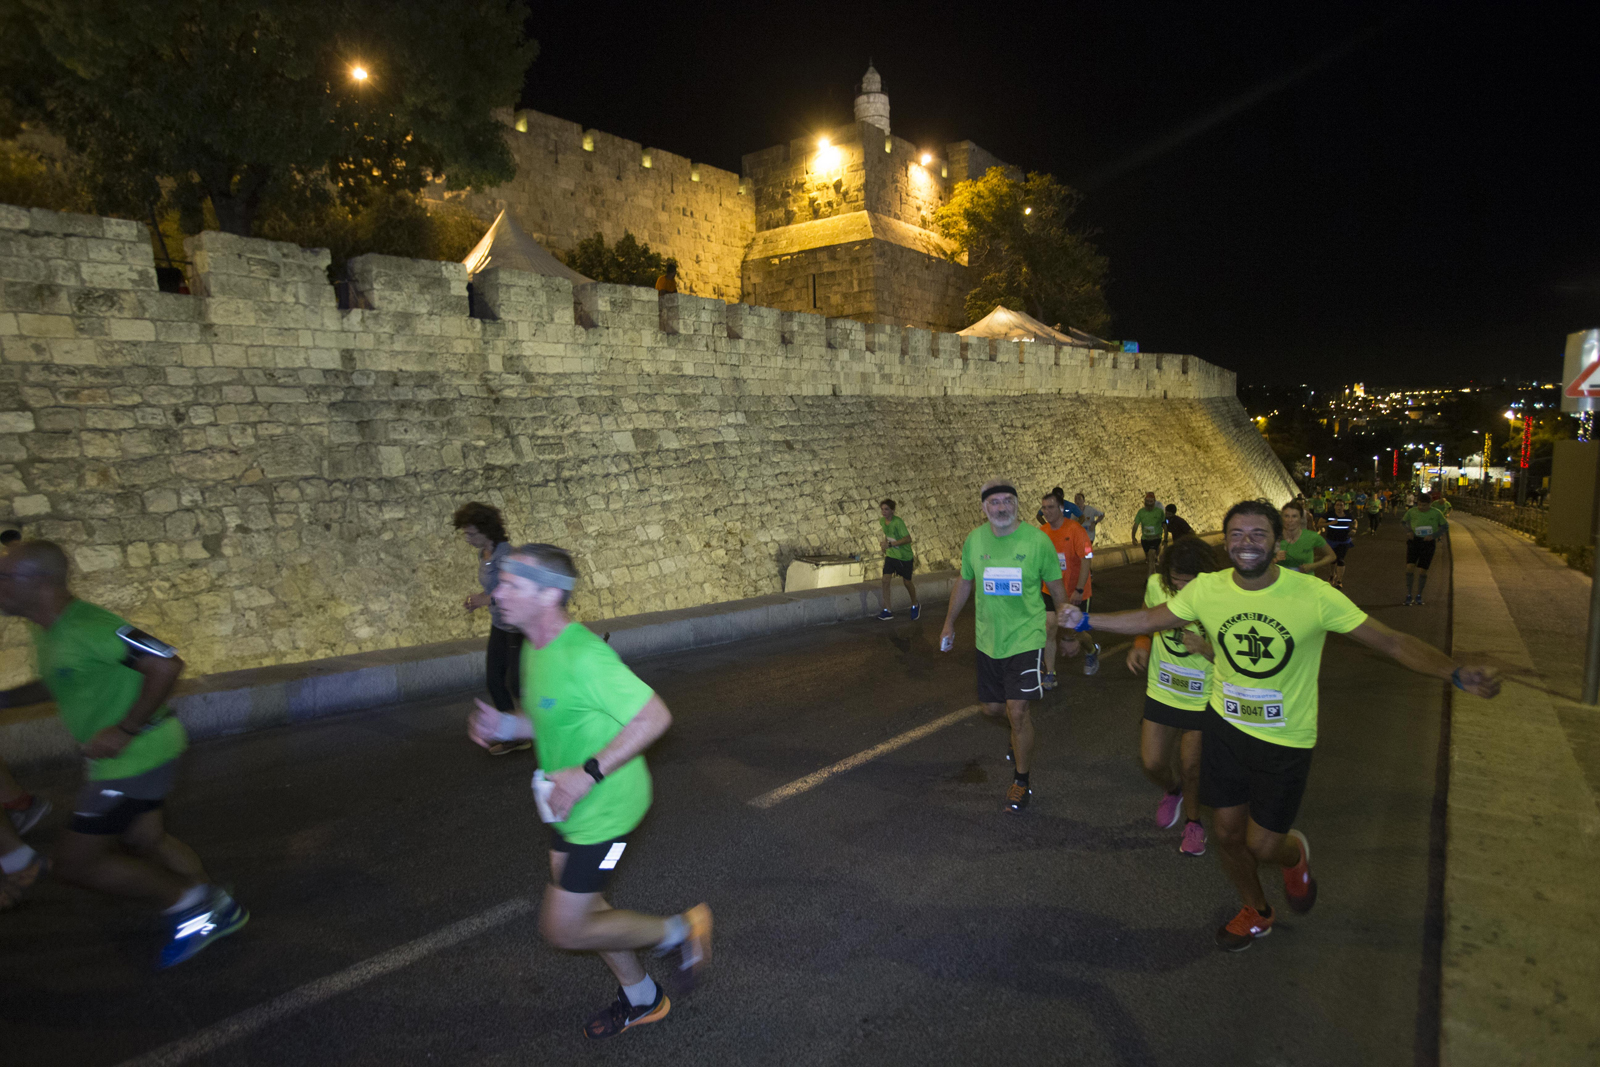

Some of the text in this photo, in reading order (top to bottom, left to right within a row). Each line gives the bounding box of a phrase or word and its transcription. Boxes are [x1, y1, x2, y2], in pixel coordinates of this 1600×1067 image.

[1219, 612, 1258, 634] MACCABI
[1261, 614, 1291, 640] ITALIA
[1241, 705, 1263, 716] 6047
